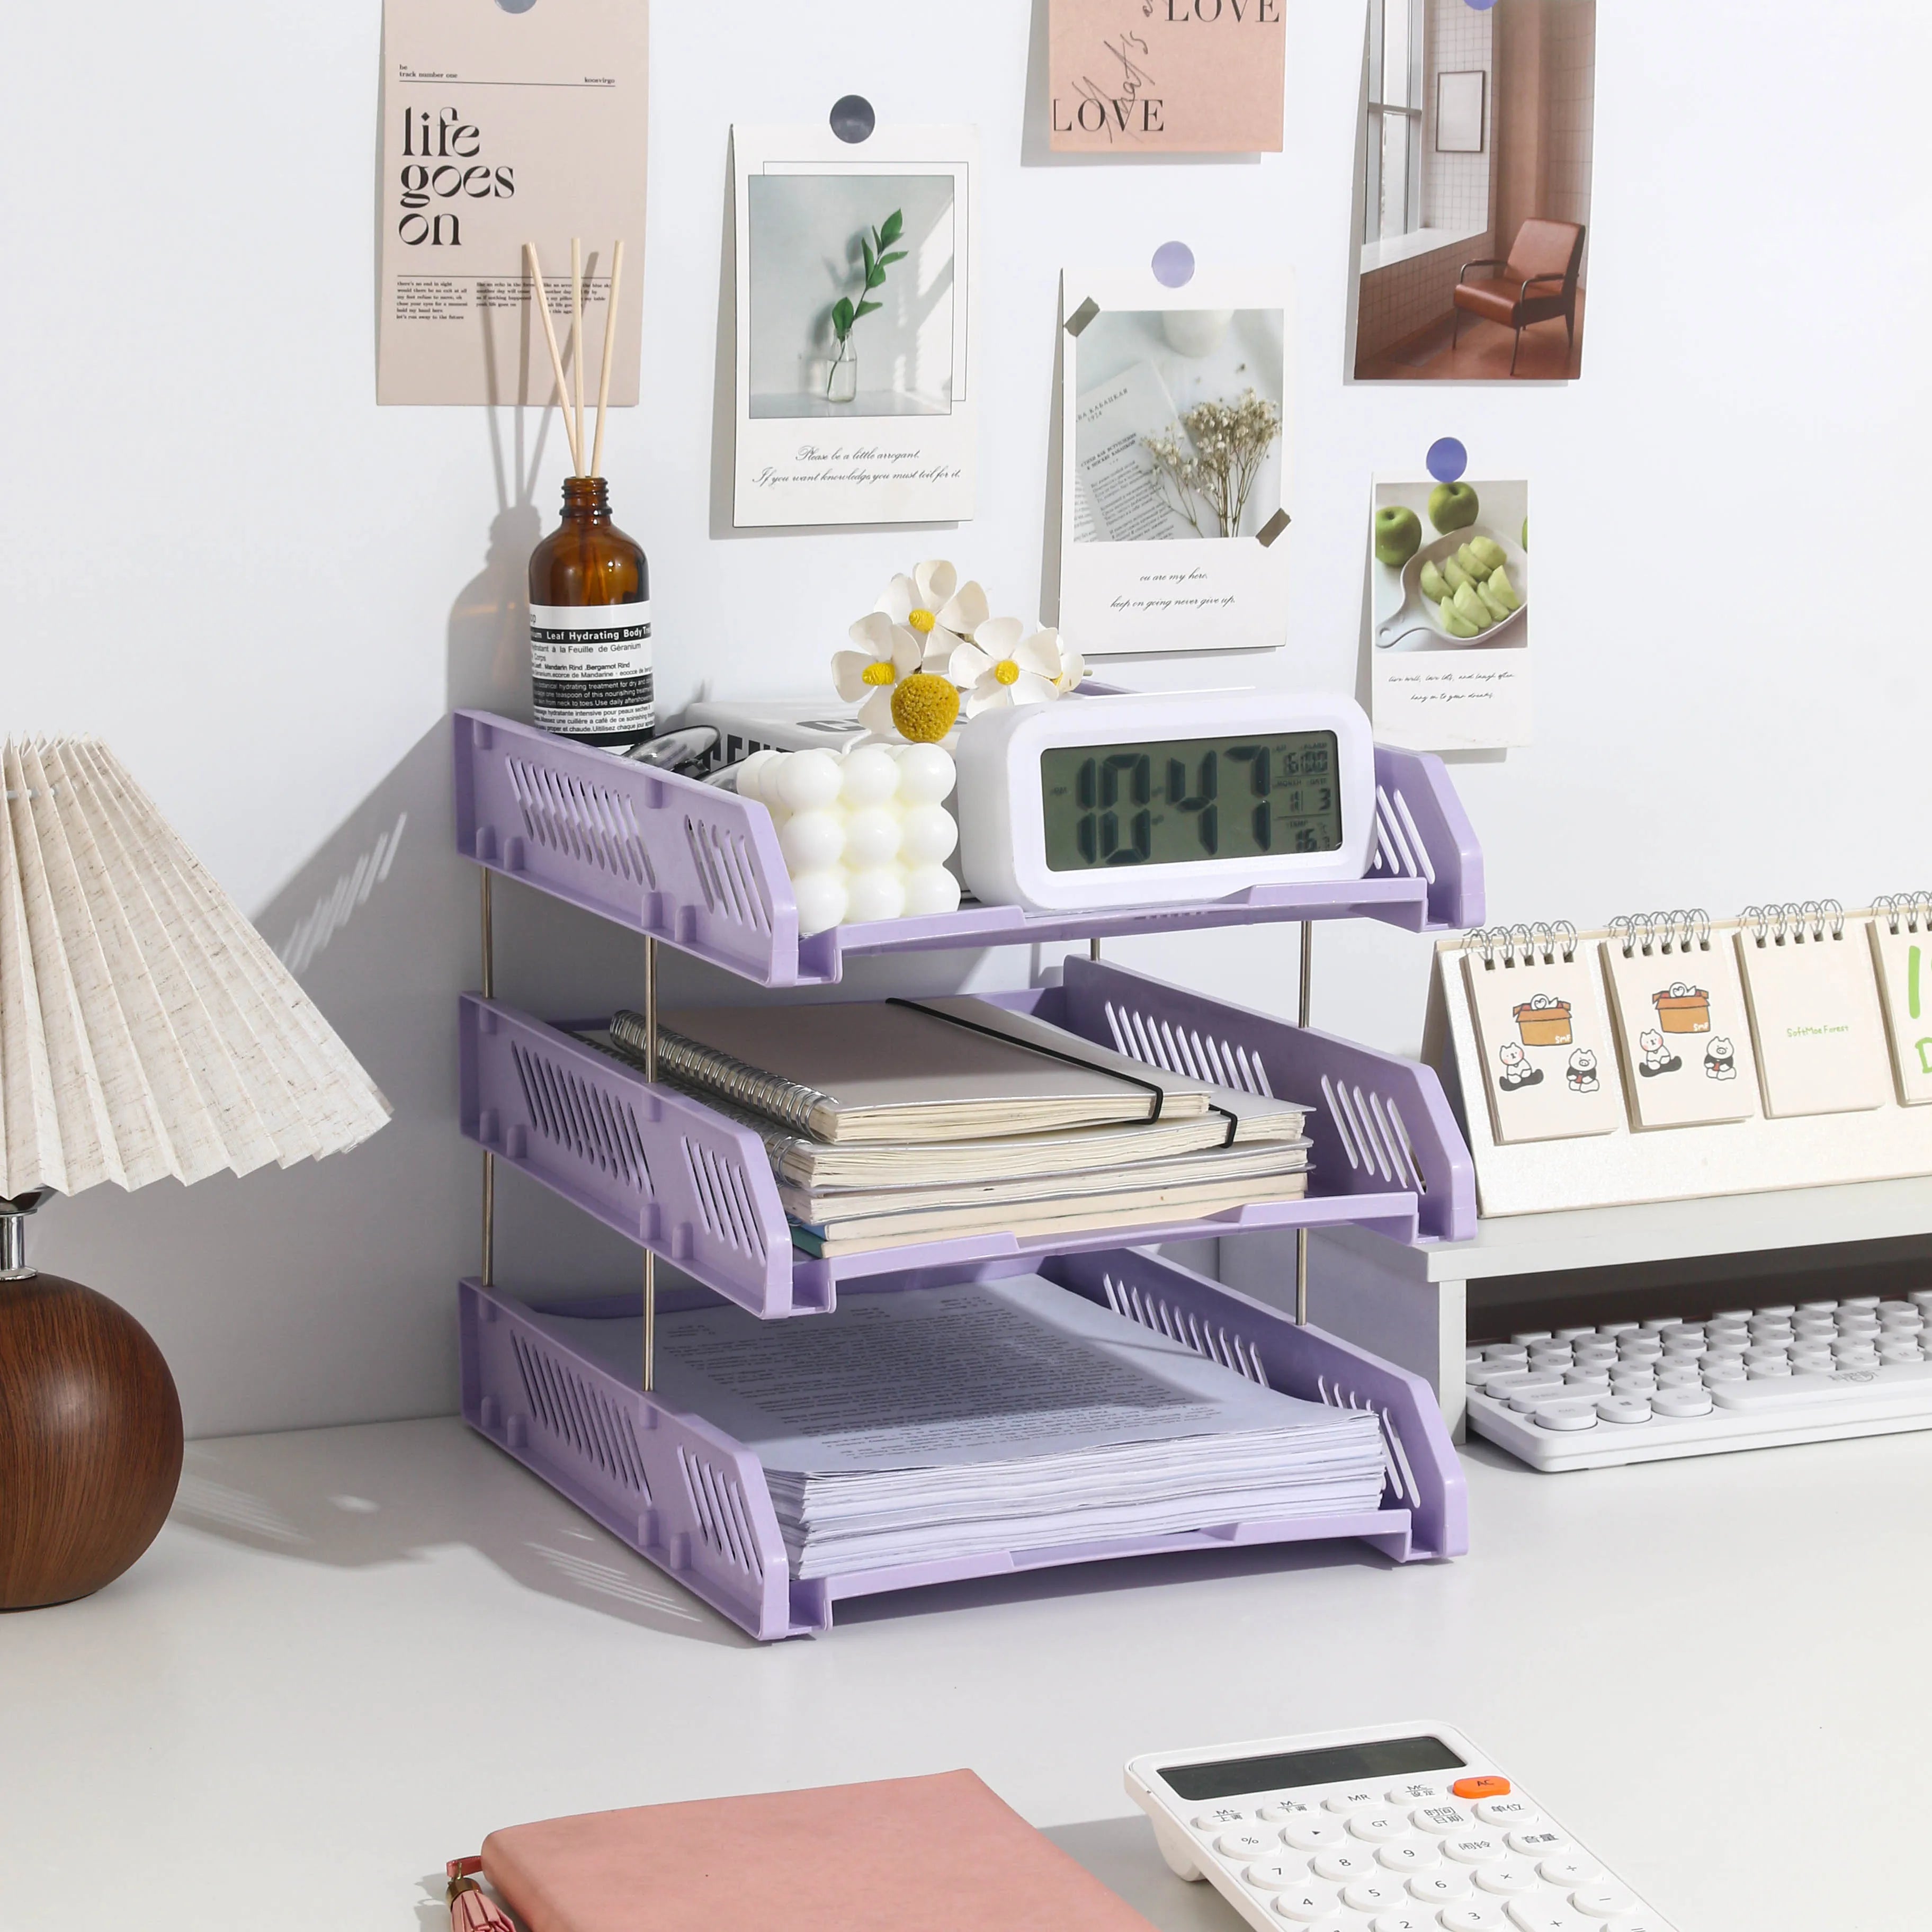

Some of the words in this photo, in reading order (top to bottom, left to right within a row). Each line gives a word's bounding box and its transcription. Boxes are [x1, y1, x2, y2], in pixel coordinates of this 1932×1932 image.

[1165, 0, 1280, 22] LOVE
[1053, 99, 1164, 132] LOVE
[403, 106, 480, 158] life
[400, 164, 515, 209] goes
[398, 213, 462, 246] on
[795, 445, 827, 461] Please
[831, 447, 843, 460] be
[853, 447, 878, 460] little
[752, 467, 777, 487] If
[768, 476, 789, 487] you
[793, 473, 820, 481] want
[820, 468, 870, 485] knowledge
[869, 473, 890, 485] you
[919, 466, 941, 479] toil
[932, 466, 949, 483] for
[1169, 574, 1186, 584] my
[1110, 595, 1130, 612] keep
[1143, 599, 1172, 611] going
[1197, 597, 1219, 609] give
[547, 631, 565, 640] Leaf
[569, 630, 620, 642] Hydrating
[623, 628, 642, 637] Body
[1318, 788, 1331, 811] 3
[1079, 746, 1271, 865] 10:47
[1823, 1025, 1849, 1034] Forest
[1424, 1806, 1457, 1817] 时间
[1491, 1803, 1525, 1813] 单位
[1433, 1814, 1464, 1824] 日期
[1521, 1833, 1559, 1844] 音量
[1458, 1840, 1491, 1851] 闹铃
[1403, 1849, 1415, 1858] 9
[1339, 1858, 1352, 1868] 8
[1435, 1880, 1447, 1890] 6
[1368, 1889, 1381, 1898] 5
[1302, 1898, 1313, 1907] 4
[1467, 1912, 1481, 1921] 3
[1399, 1920, 1414, 1930] 2
